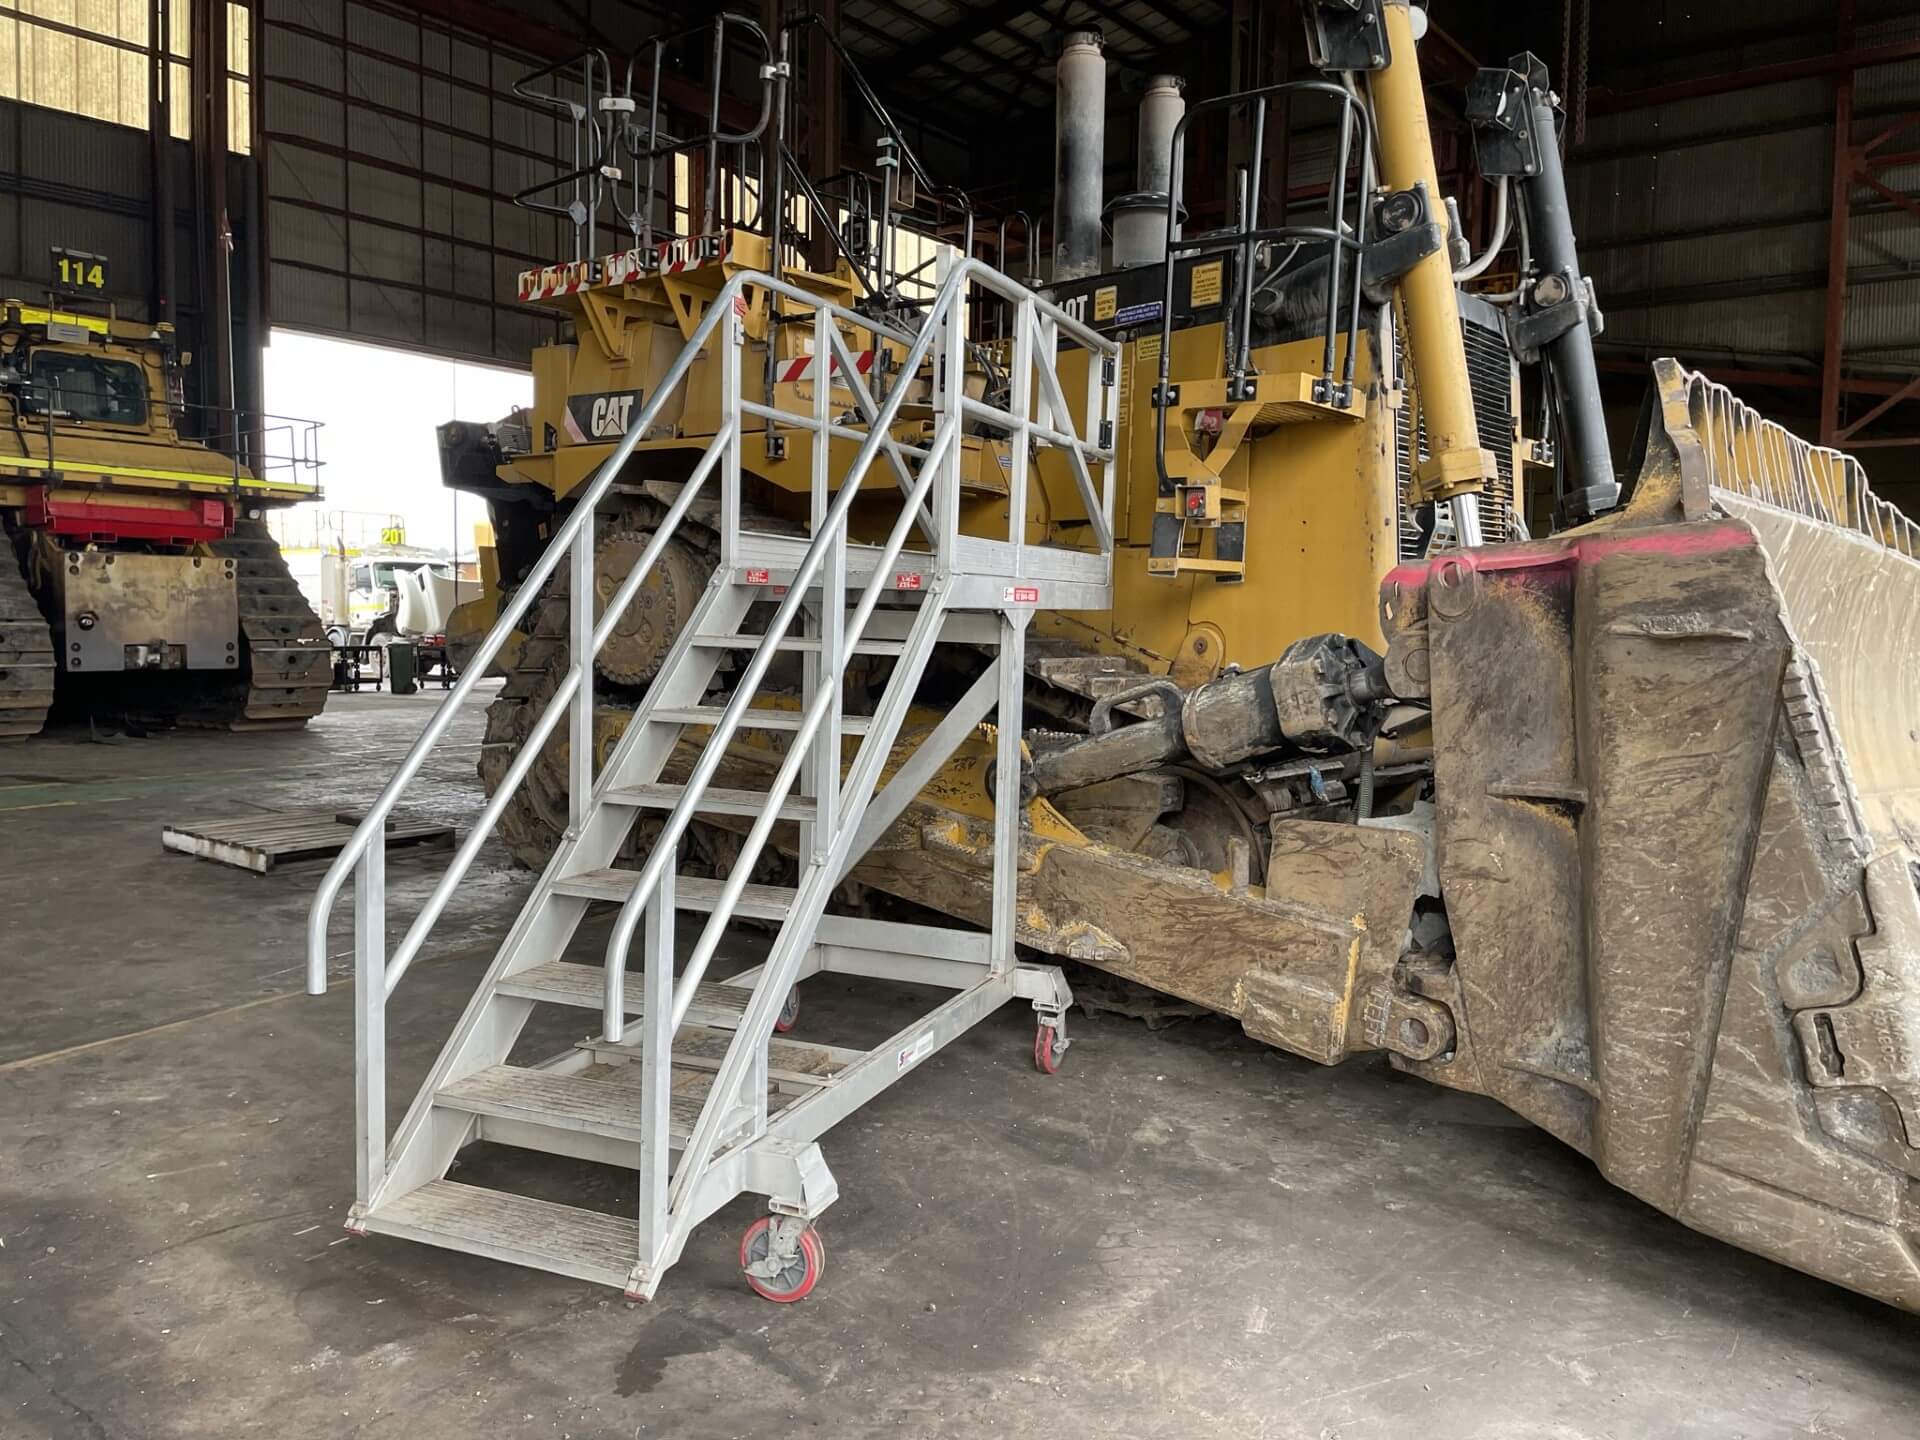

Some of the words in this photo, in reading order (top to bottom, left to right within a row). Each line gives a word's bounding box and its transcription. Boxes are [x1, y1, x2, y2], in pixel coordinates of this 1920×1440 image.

[58, 258, 105, 288] 114
[592, 397, 634, 437] CAT
[382, 528, 405, 544] 201
